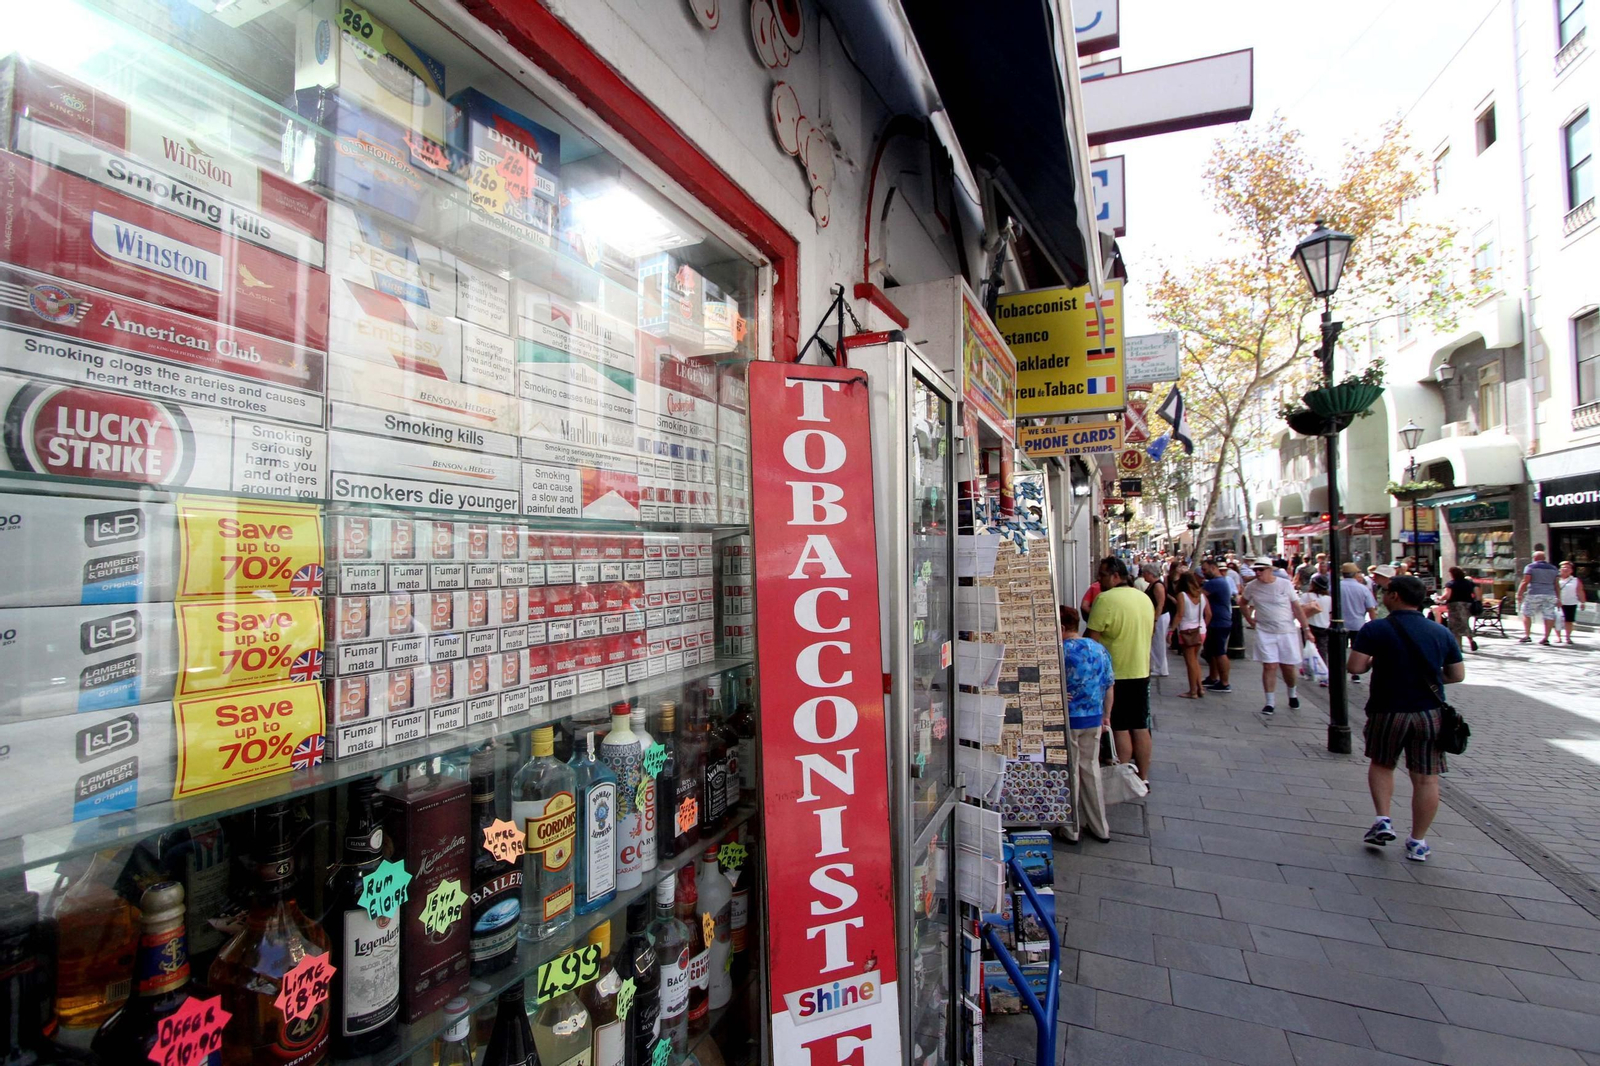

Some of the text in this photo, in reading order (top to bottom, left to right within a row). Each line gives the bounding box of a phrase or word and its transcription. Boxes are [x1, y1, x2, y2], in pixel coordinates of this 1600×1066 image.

[49, 101, 74, 117] KING
[488, 127, 543, 164] DRUM
[162, 135, 232, 188] Winston
[473, 170, 497, 191] 250
[5, 161, 16, 250] AMERICAN FLAVOR
[107, 159, 271, 239] Smoking kills
[114, 224, 208, 281] Winston
[349, 242, 441, 292] REGAL
[236, 288, 276, 303] CLASSIC
[996, 297, 1077, 319] Tobacconist
[101, 311, 210, 351] American
[216, 340, 262, 364] Club
[357, 321, 443, 359] Embassy
[476, 338, 503, 353] Smoking
[1000, 331, 1049, 345] stanco
[465, 345, 513, 365] seriously harms
[466, 356, 511, 374] you and others
[1017, 354, 1070, 372] aklader
[24, 339, 305, 407] Smoking clogs the arteries and causes
[472, 366, 494, 378] around
[676, 363, 709, 386] LEGEND
[1134, 366, 1176, 374] Bordado
[86, 369, 266, 412] heart attacks and strokes
[524, 381, 557, 398] Smoking
[559, 391, 584, 402] causes
[584, 394, 598, 405] fatal
[614, 405, 634, 415] cancer
[1038, 389, 1045, 397] de
[1044, 381, 1084, 396] Tabac
[420, 391, 458, 408] BENSON
[465, 402, 497, 416] HEDGES
[667, 392, 695, 417] Chesterfield
[57, 406, 161, 446] LUCKY
[385, 415, 484, 446] Smoking kills
[561, 417, 608, 447] Marlboro
[656, 417, 687, 434] Smoking
[252, 426, 312, 446] Smoking
[1024, 427, 1116, 452] PHONE CARDS
[48, 438, 161, 475] STRIKE
[251, 442, 312, 460] seriously
[1082, 445, 1112, 453] STAMPS
[246, 454, 317, 472] harms you
[1123, 453, 1138, 466] 41
[244, 468, 317, 485] and others
[535, 469, 570, 482] Smoking
[241, 482, 318, 499] around you
[335, 479, 517, 512] Smokers die younger
[538, 493, 557, 503] slow
[560, 494, 574, 503] and
[550, 484, 573, 492] cause
[526, 504, 578, 516] painful death
[93, 514, 139, 540] L&B
[218, 518, 293, 540] Save
[237, 540, 280, 554] up to
[88, 564, 139, 580] & BUTLER
[89, 556, 140, 571] LAMBERT
[220, 556, 292, 580] 70%
[347, 567, 380, 577] Fumar
[102, 578, 142, 590] Original
[350, 581, 376, 590] mata
[216, 611, 293, 632] Save
[235, 630, 280, 647] up to
[219, 644, 292, 675] 70%
[554, 678, 574, 688] Fumar
[783, 377, 864, 975] TOBACCONIST
[557, 689, 572, 698] mata
[216, 700, 293, 726] Save
[86, 720, 133, 757] L&B
[235, 721, 280, 740] up to
[343, 725, 377, 740] Fumar
[218, 733, 293, 769] 70%
[348, 739, 374, 753] mata
[80, 762, 133, 789] LAMBERT
[80, 771, 133, 796] & BUTLER
[94, 785, 133, 805] Original
[591, 791, 611, 804] BOMBAY
[543, 835, 558, 845] LONDON
[591, 824, 612, 839] SAPPHIRE
[470, 873, 523, 905] BAILEYS
[538, 944, 601, 999] 4.99
[799, 982, 874, 1016] Shine
